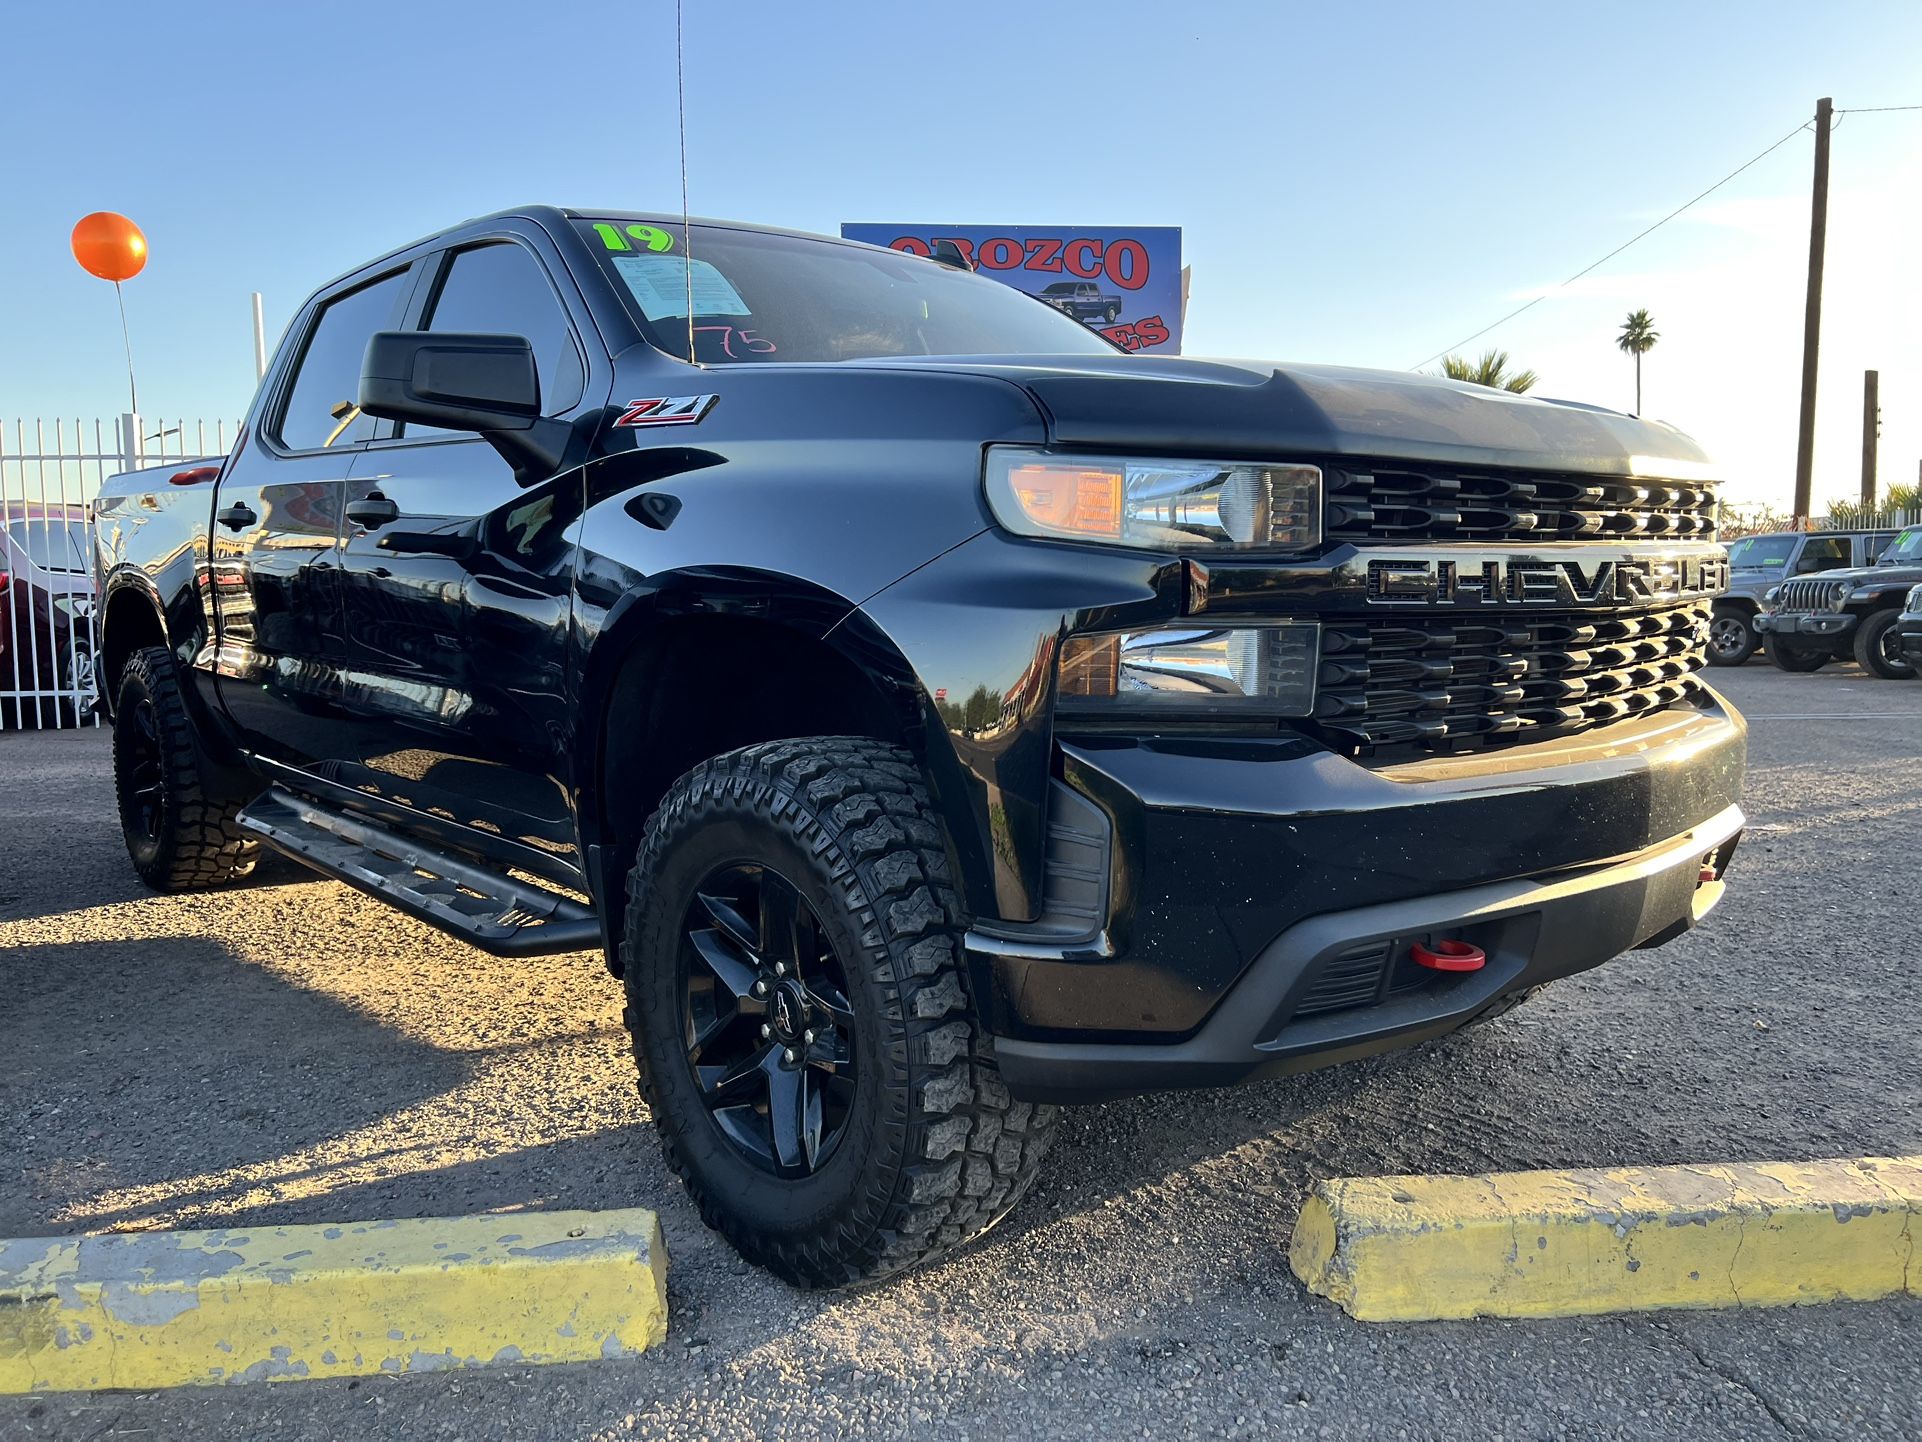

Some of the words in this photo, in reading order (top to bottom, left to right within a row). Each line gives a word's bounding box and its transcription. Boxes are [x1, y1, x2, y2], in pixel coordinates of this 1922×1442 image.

[592, 223, 674, 253] 19
[612, 393, 721, 428] Z71
[1366, 559, 1729, 605] CHEVROLET
